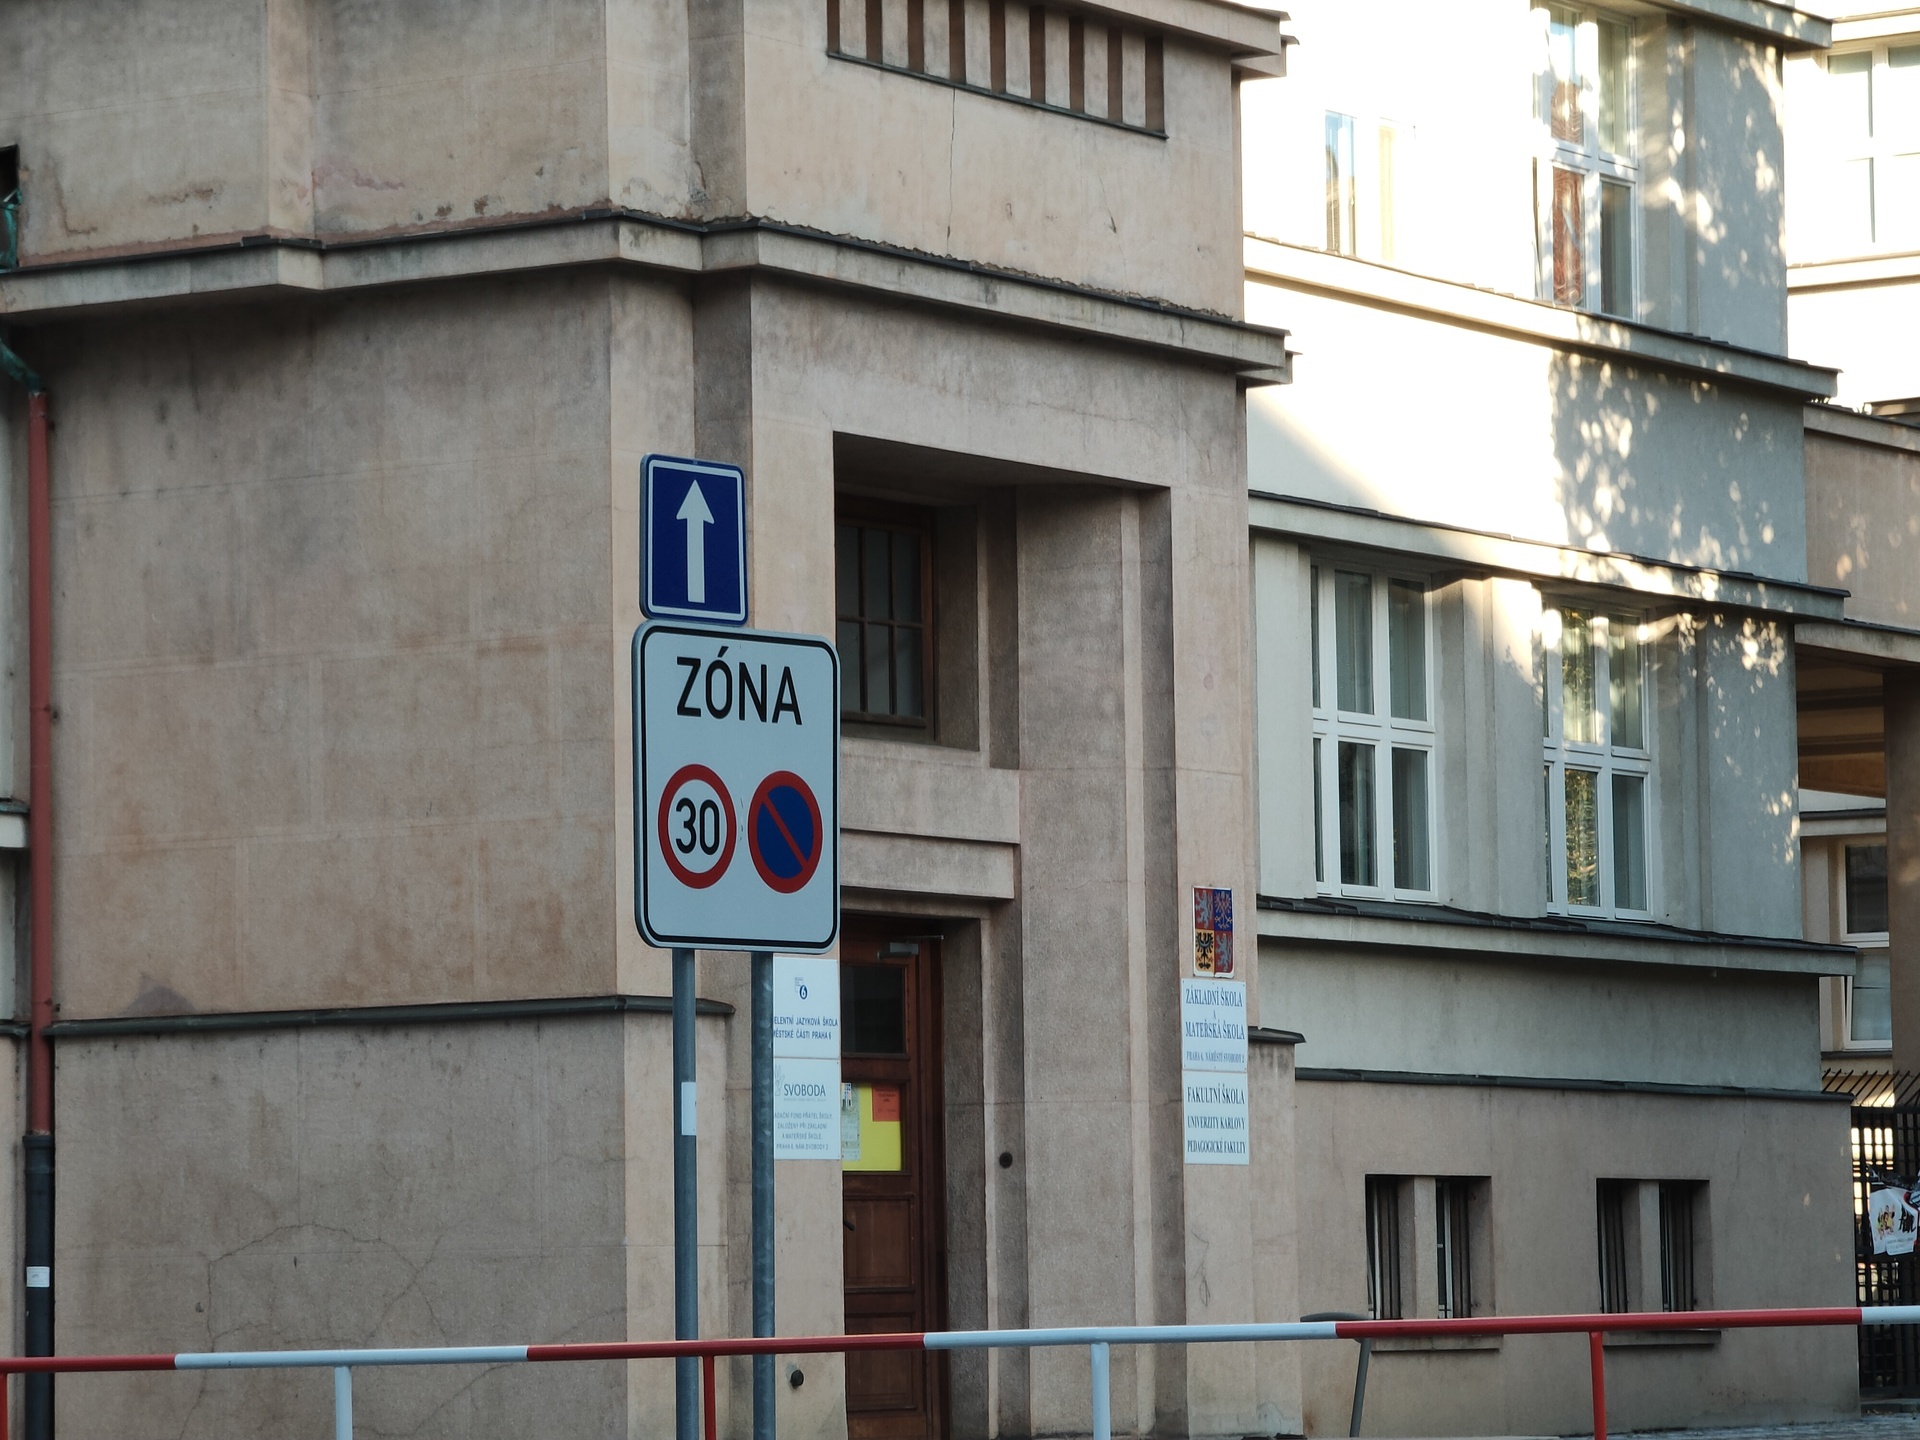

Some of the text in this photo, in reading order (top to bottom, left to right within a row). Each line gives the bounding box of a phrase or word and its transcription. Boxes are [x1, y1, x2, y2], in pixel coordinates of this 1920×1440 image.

[676, 646, 803, 726] ZÓNA
[675, 797, 720, 856] 30
[1186, 985, 1243, 1007] ZÁKLADNÍ ŠKOLA
[796, 1016, 821, 1026] JAZYKOVÁ
[822, 1016, 838, 1027] ŠKOLA
[1213, 1010, 1216, 1020] A
[796, 1029, 811, 1039] ČÁSTI
[1185, 1019, 1245, 1040] MATEŘSKÁ ŠKOLA
[783, 1084, 826, 1096] SVOBODA
[1187, 1082, 1245, 1105] FAKULTNÍ ŠKOLA
[1187, 1116, 1245, 1130] UNIVERZITY KARLOVY
[1187, 1137, 1246, 1154] PEDAGOGICKÉ FAKULTY
